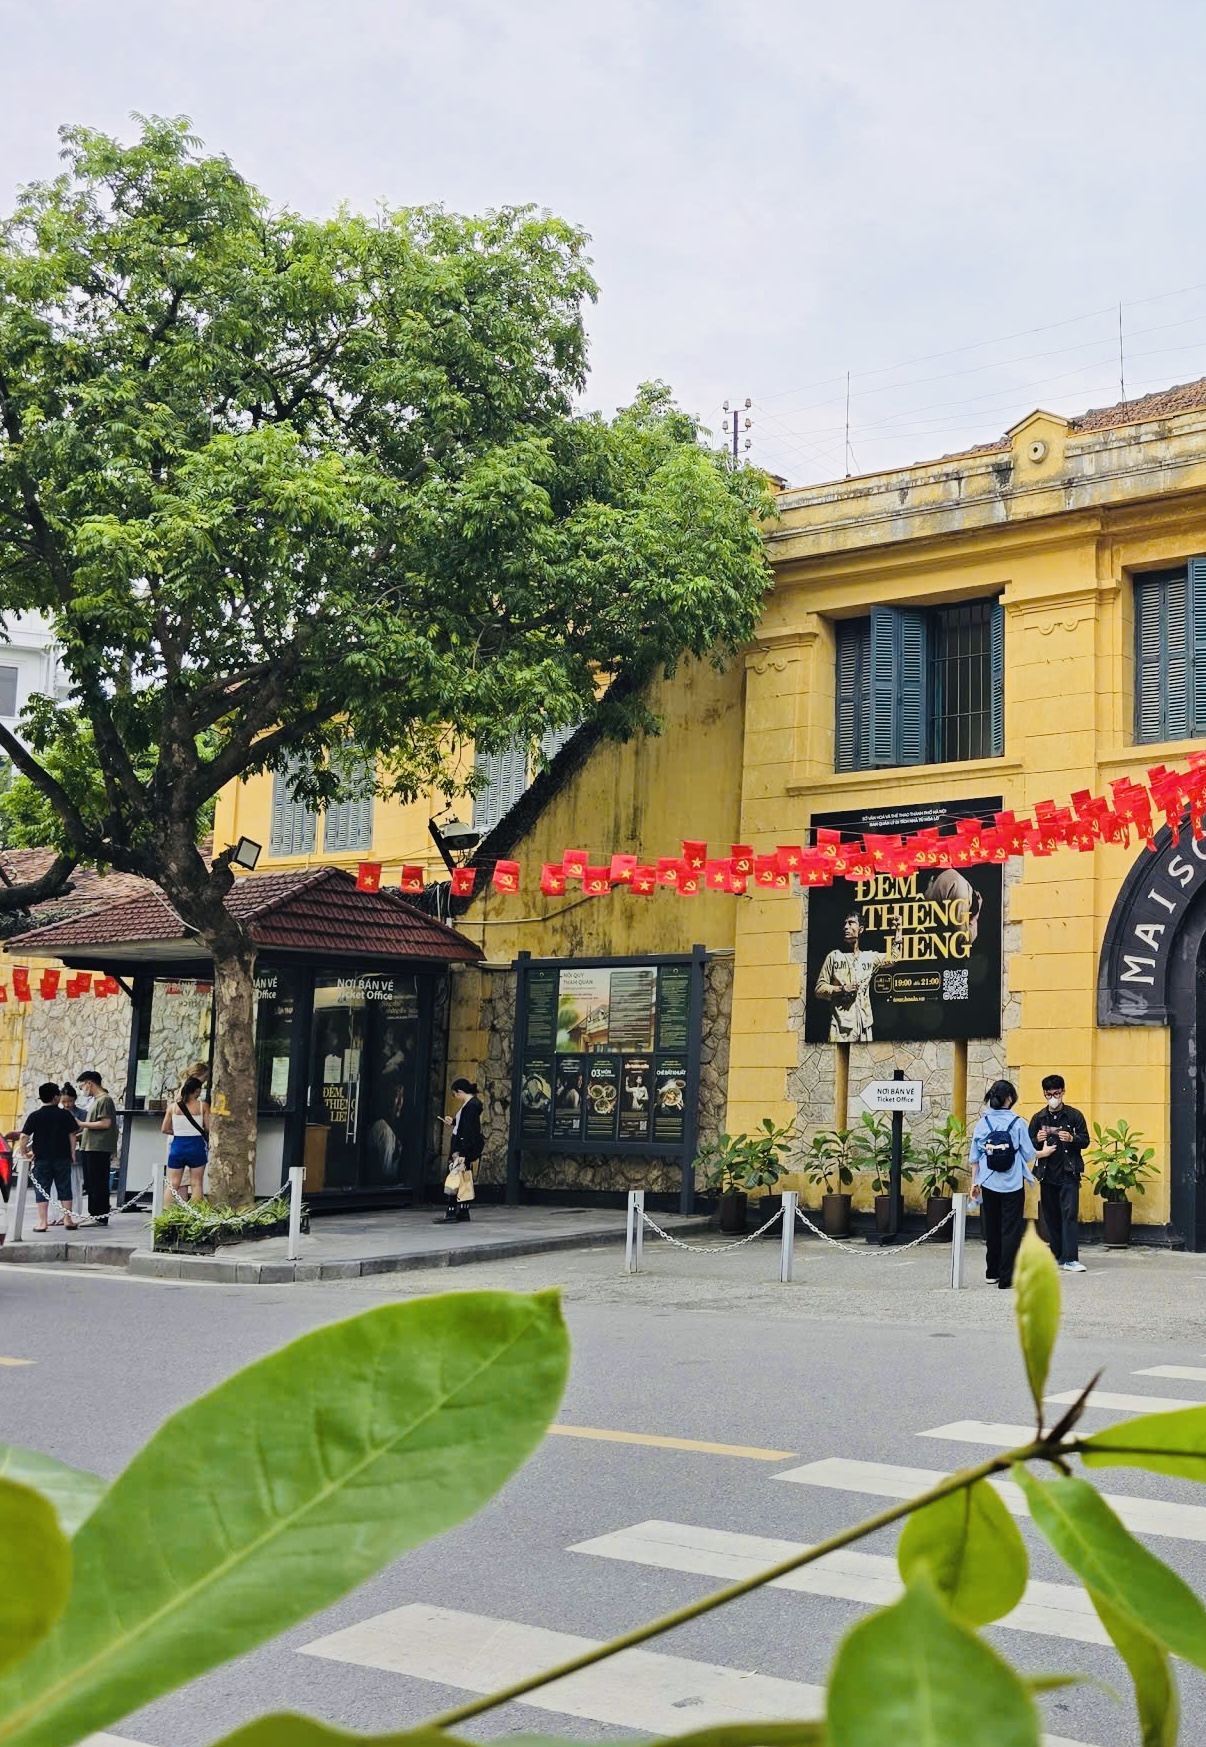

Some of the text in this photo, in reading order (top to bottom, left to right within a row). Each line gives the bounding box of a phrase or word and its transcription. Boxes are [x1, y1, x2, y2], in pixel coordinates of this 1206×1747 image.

[267, 976, 278, 988] VÉ
[337, 977, 394, 991] NƠI BÁN VÉ
[257, 990, 277, 1000] Office
[366, 990, 393, 1001] Office
[590, 1069, 601, 1078] 03
